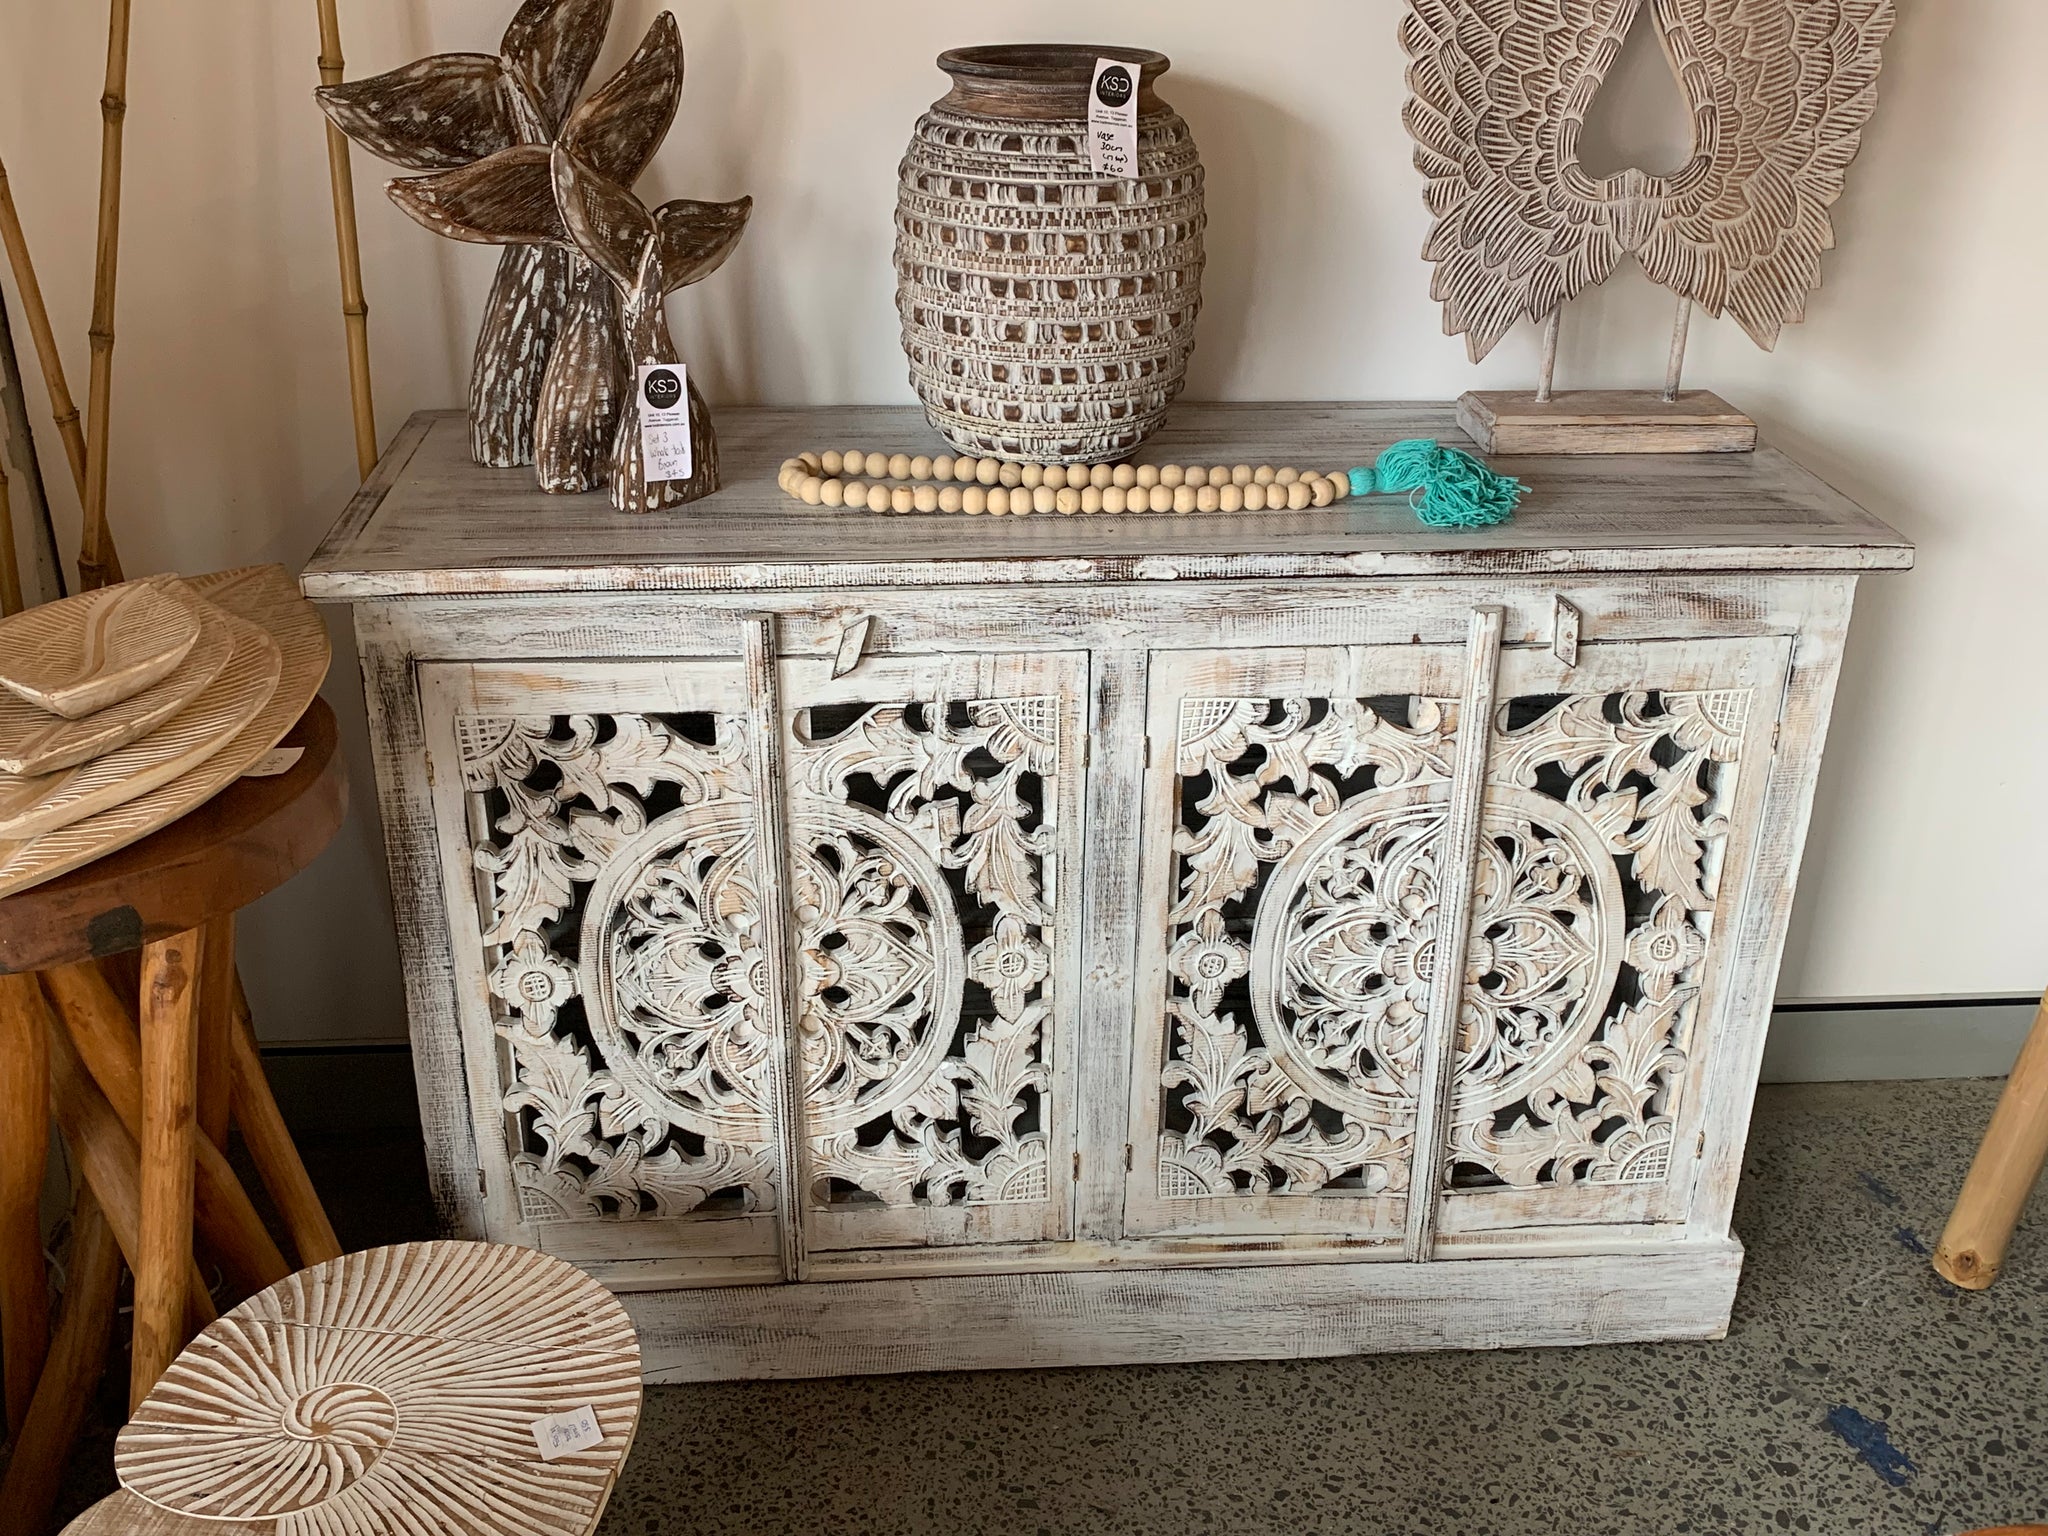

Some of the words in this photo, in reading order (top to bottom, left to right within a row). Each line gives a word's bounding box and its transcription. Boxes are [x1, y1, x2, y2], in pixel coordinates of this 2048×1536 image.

[1100, 75, 1129, 93] KSD
[1097, 131, 1115, 141] Vase
[1100, 141, 1123, 152] 30cm
[1102, 163, 1124, 173] $60
[648, 379, 678, 394] KSD
[662, 431, 669, 443] 3
